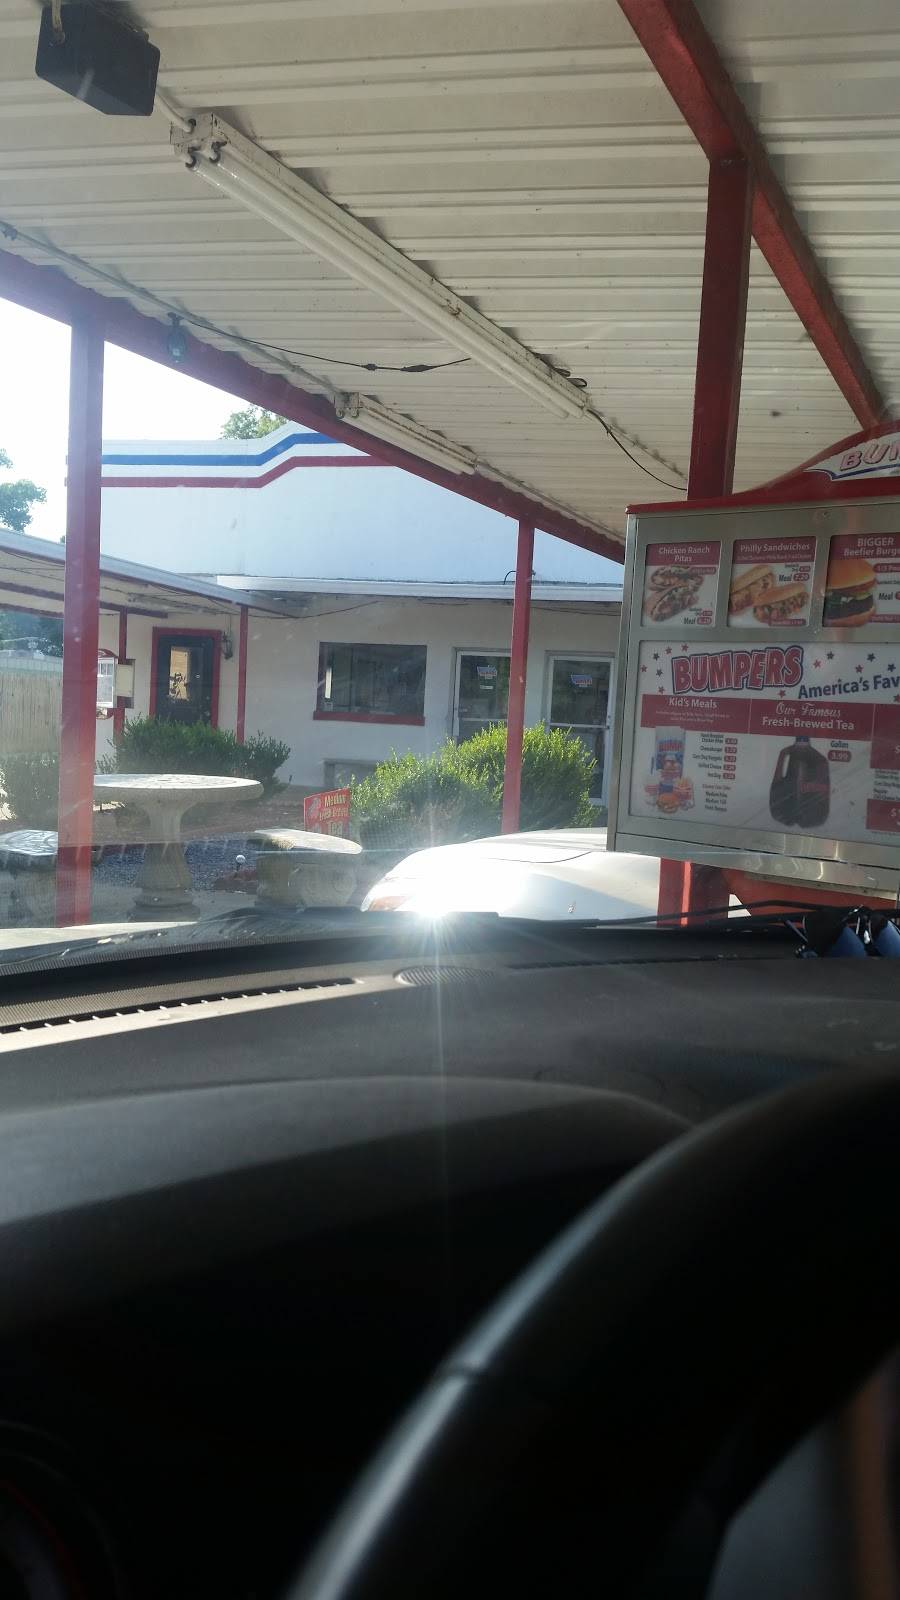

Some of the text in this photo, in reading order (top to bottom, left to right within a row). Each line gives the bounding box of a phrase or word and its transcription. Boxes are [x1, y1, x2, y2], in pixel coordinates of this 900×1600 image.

[740, 542, 810, 554] Philly Sandwiches
[857, 537, 895, 547] BIGGER
[658, 545, 710, 555] Chicken Ranch
[843, 548, 875, 556] Beefier
[878, 592, 894, 600] Meal
[672, 645, 803, 694] BUMPERS
[798, 677, 870, 699] America's
[668, 697, 718, 709] Kid's Meals
[775, 701, 841, 718] Our Famous
[762, 716, 855, 730] Fresh-Brewed Tea
